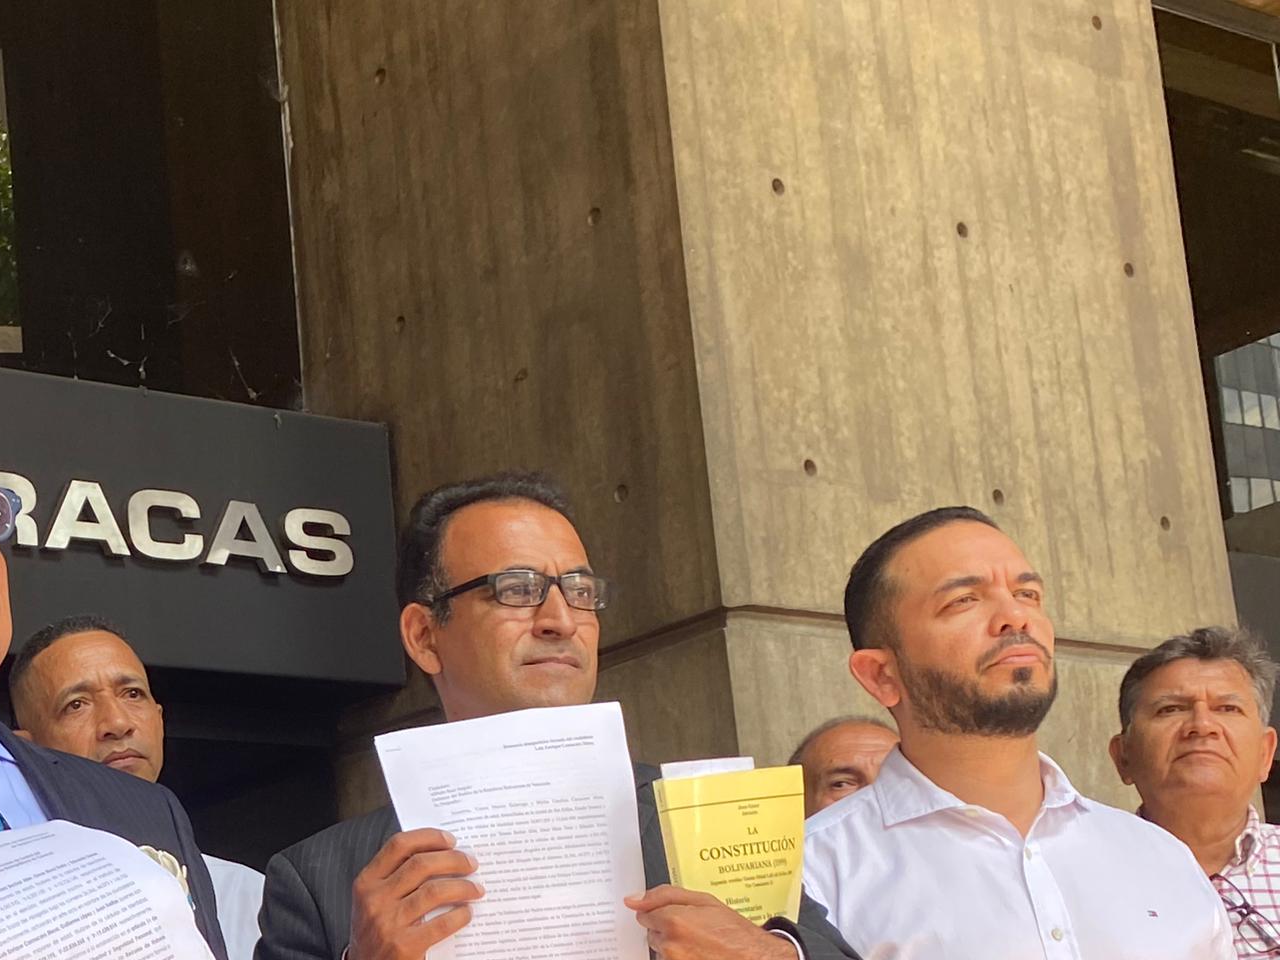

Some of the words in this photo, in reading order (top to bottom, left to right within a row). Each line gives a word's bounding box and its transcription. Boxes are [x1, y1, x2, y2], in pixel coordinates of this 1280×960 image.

[747, 827, 758, 835] LA
[699, 835, 796, 861] CONSTITUCIÓN
[718, 859, 772, 874] BOLIVARIANA
